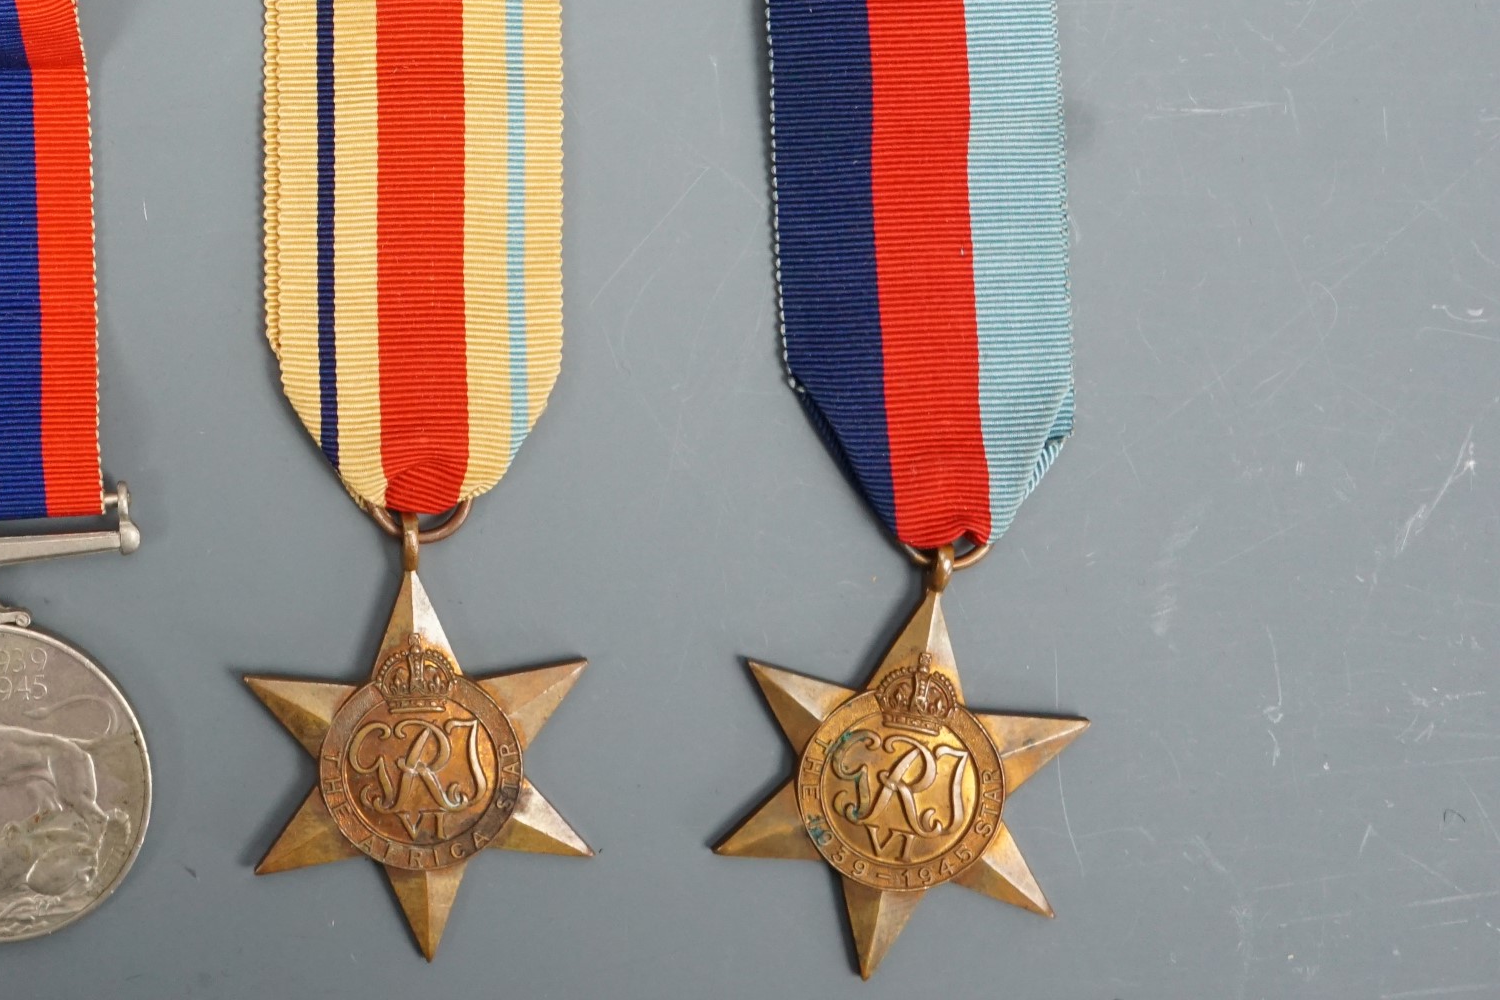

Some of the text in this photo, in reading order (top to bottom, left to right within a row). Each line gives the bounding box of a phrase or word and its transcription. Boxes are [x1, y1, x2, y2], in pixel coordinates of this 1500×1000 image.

[323, 743, 522, 868] THE AFRICA STAR
[801, 738, 833, 800] THE
[975, 768, 1004, 839] STAR
